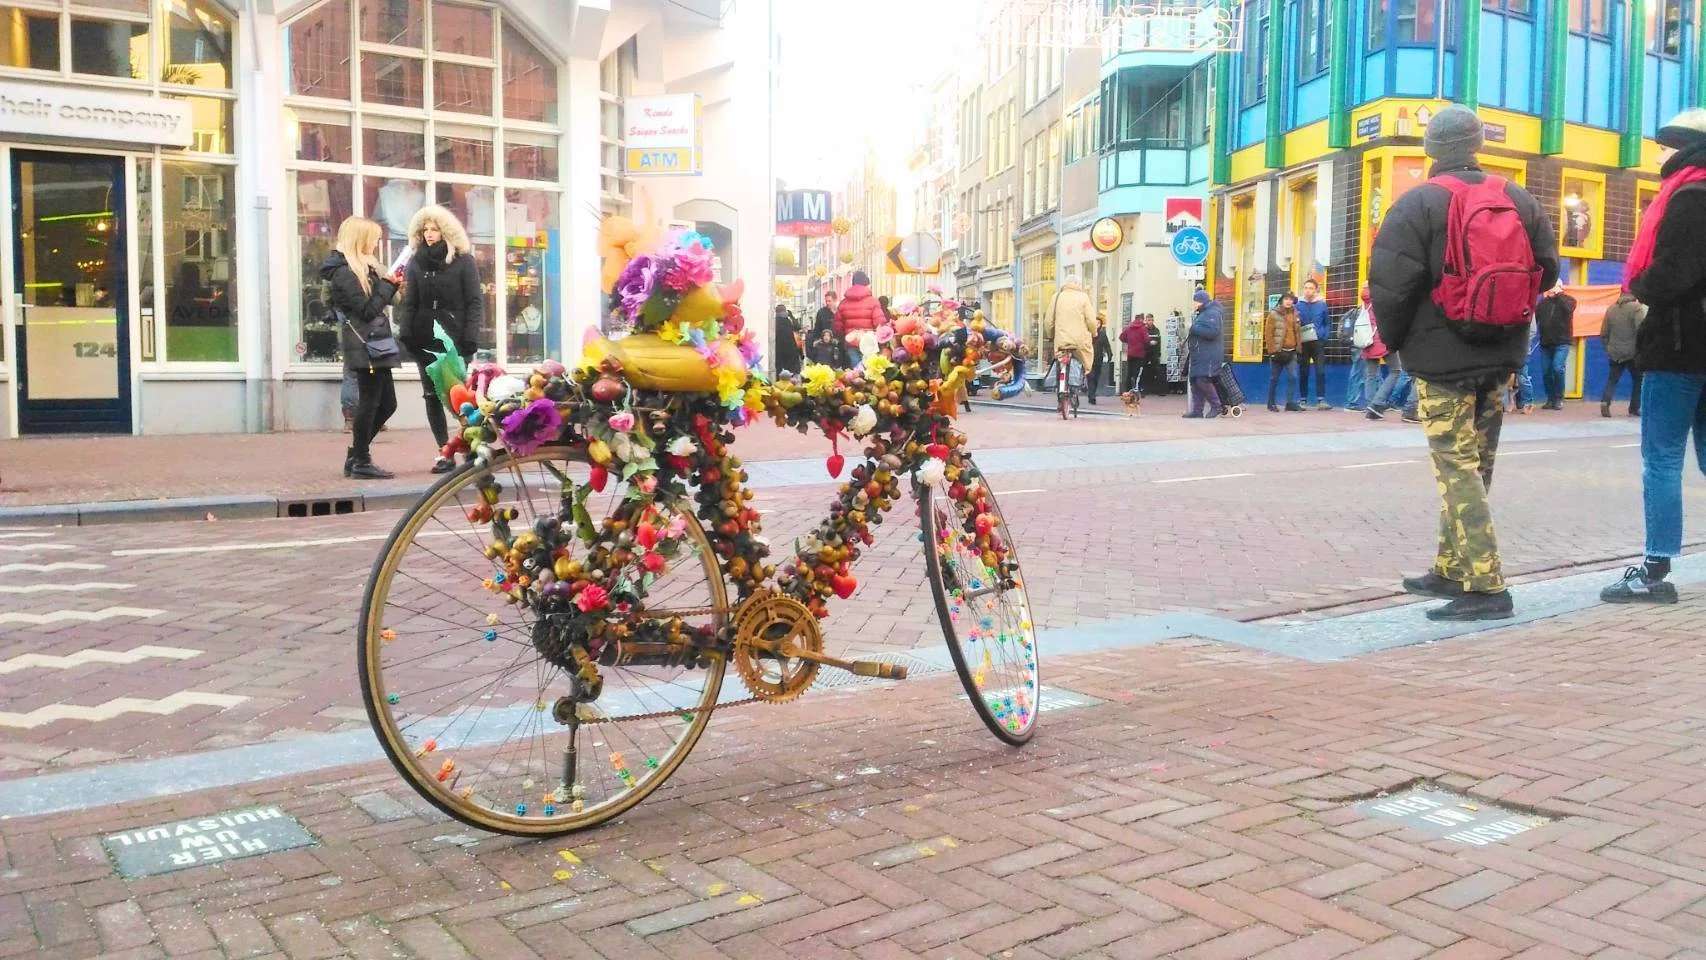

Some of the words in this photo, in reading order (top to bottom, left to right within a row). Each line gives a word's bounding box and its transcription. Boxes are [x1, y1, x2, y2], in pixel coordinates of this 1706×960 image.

[59, 104, 181, 133] company
[640, 152, 678, 167] ATM
[803, 192, 826, 220] M
[73, 342, 116, 357] 124
[1372, 796, 1444, 817] HIER
[109, 808, 281, 845] HUISVUIL
[1420, 808, 1477, 827] UW
[180, 829, 240, 849] UW
[168, 838, 267, 865] HIER
